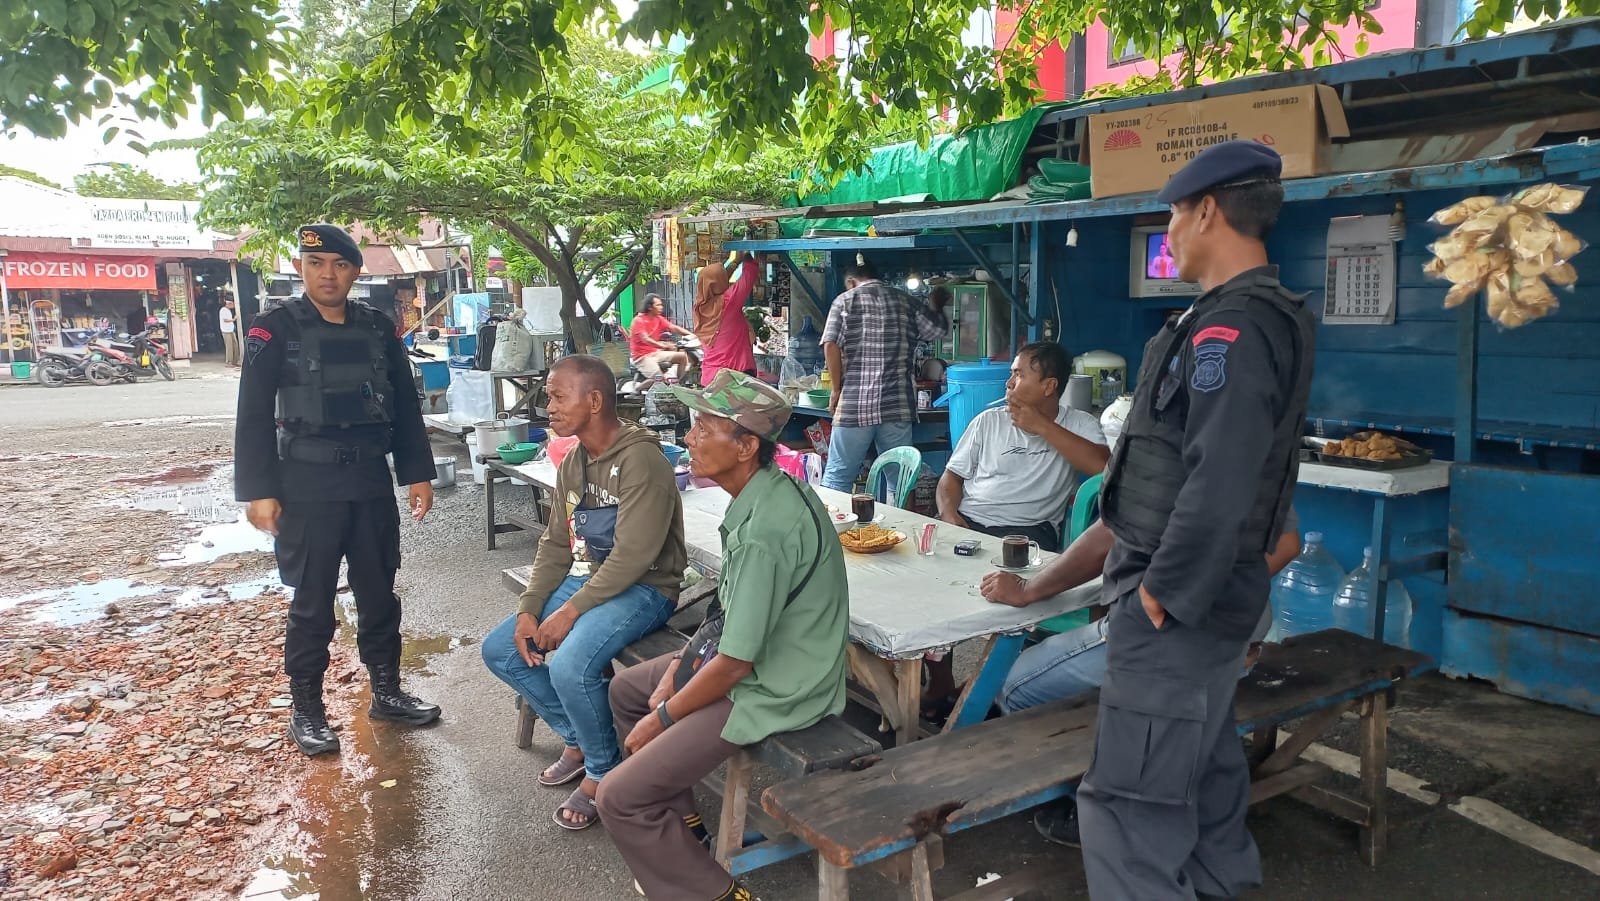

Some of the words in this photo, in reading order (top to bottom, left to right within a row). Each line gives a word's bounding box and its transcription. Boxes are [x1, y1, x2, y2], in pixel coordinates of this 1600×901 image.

[1167, 129, 1176, 137] IF
[1157, 139, 1192, 152] ROMAN
[1184, 151, 1195, 160] 10
[5, 262, 86, 277] FROZEN
[94, 263, 149, 278] FOOD
